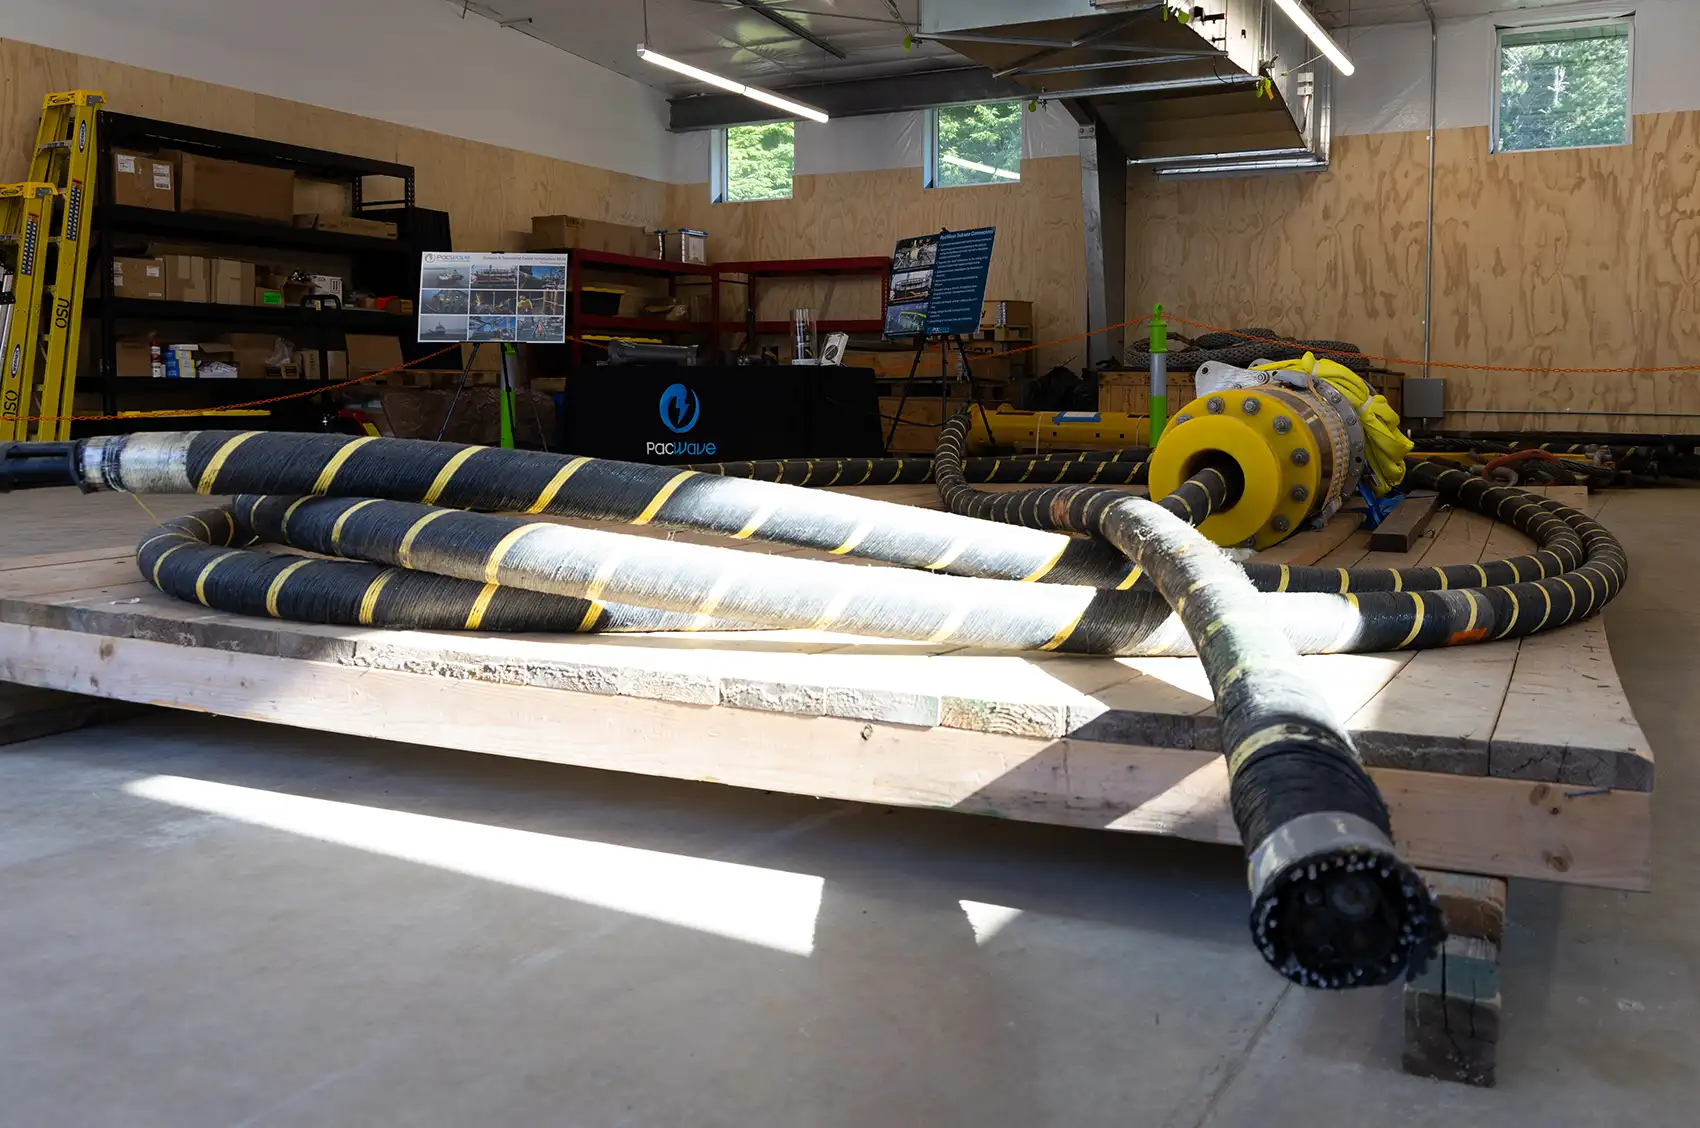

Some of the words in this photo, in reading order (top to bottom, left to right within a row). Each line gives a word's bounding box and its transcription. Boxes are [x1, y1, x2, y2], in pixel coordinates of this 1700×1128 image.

[55, 298, 70, 329] OSU
[2, 390, 19, 421] OSU
[646, 441, 717, 455] PacWave
